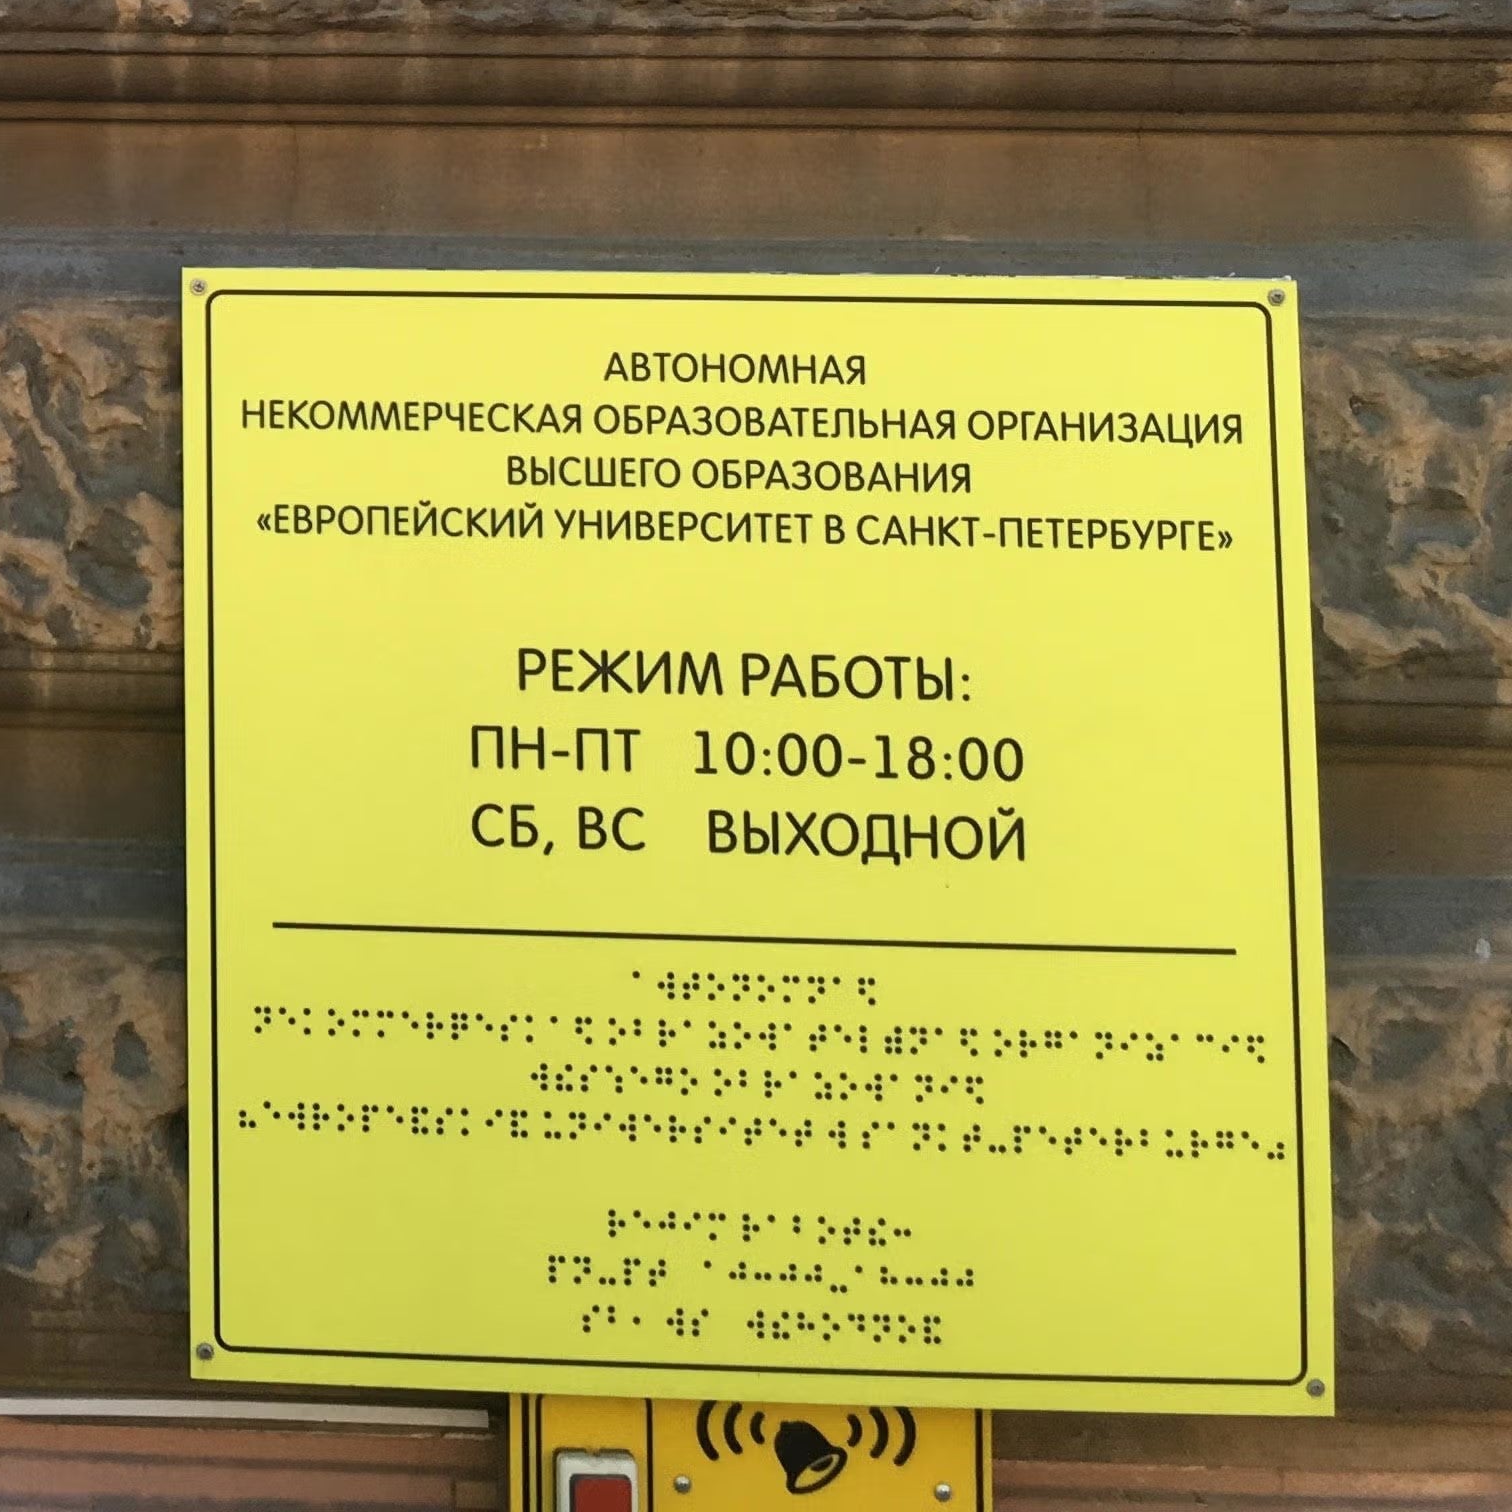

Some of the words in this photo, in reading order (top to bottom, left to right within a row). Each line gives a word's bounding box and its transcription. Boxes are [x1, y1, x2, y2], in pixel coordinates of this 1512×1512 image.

[603, 351, 866, 386] АВТОНОМНАЯ
[241, 398, 582, 435] НЕКОММЕРЧЕСКАЯ
[593, 403, 956, 441] ОБРАЗОВАТЕЛЬНАЯ
[967, 409, 1243, 450] ОРГАНИЗАЦИЯ
[506, 455, 682, 489] ВЫСШЕГО
[691, 457, 972, 494] ОБРАЗОВАНИЯ
[256, 499, 544, 540] «ЕВРОПЕЙСКИЙ
[553, 508, 814, 545] УНИВЕРСИТЕТ
[824, 513, 846, 545] В
[855, 514, 1234, 552] САНКТ-ПЕТЕРБУРГЕ»
[517, 647, 724, 697] РЕЖИМ
[740, 652, 971, 702] РАБОТЫ:
[470, 724, 642, 773] ПН-ПТ
[693, 729, 1024, 783] 10:00-18:00
[471, 802, 555, 857] СБ,
[577, 805, 646, 852] ВС
[707, 805, 1026, 867] ВЫХОДНОЙ
